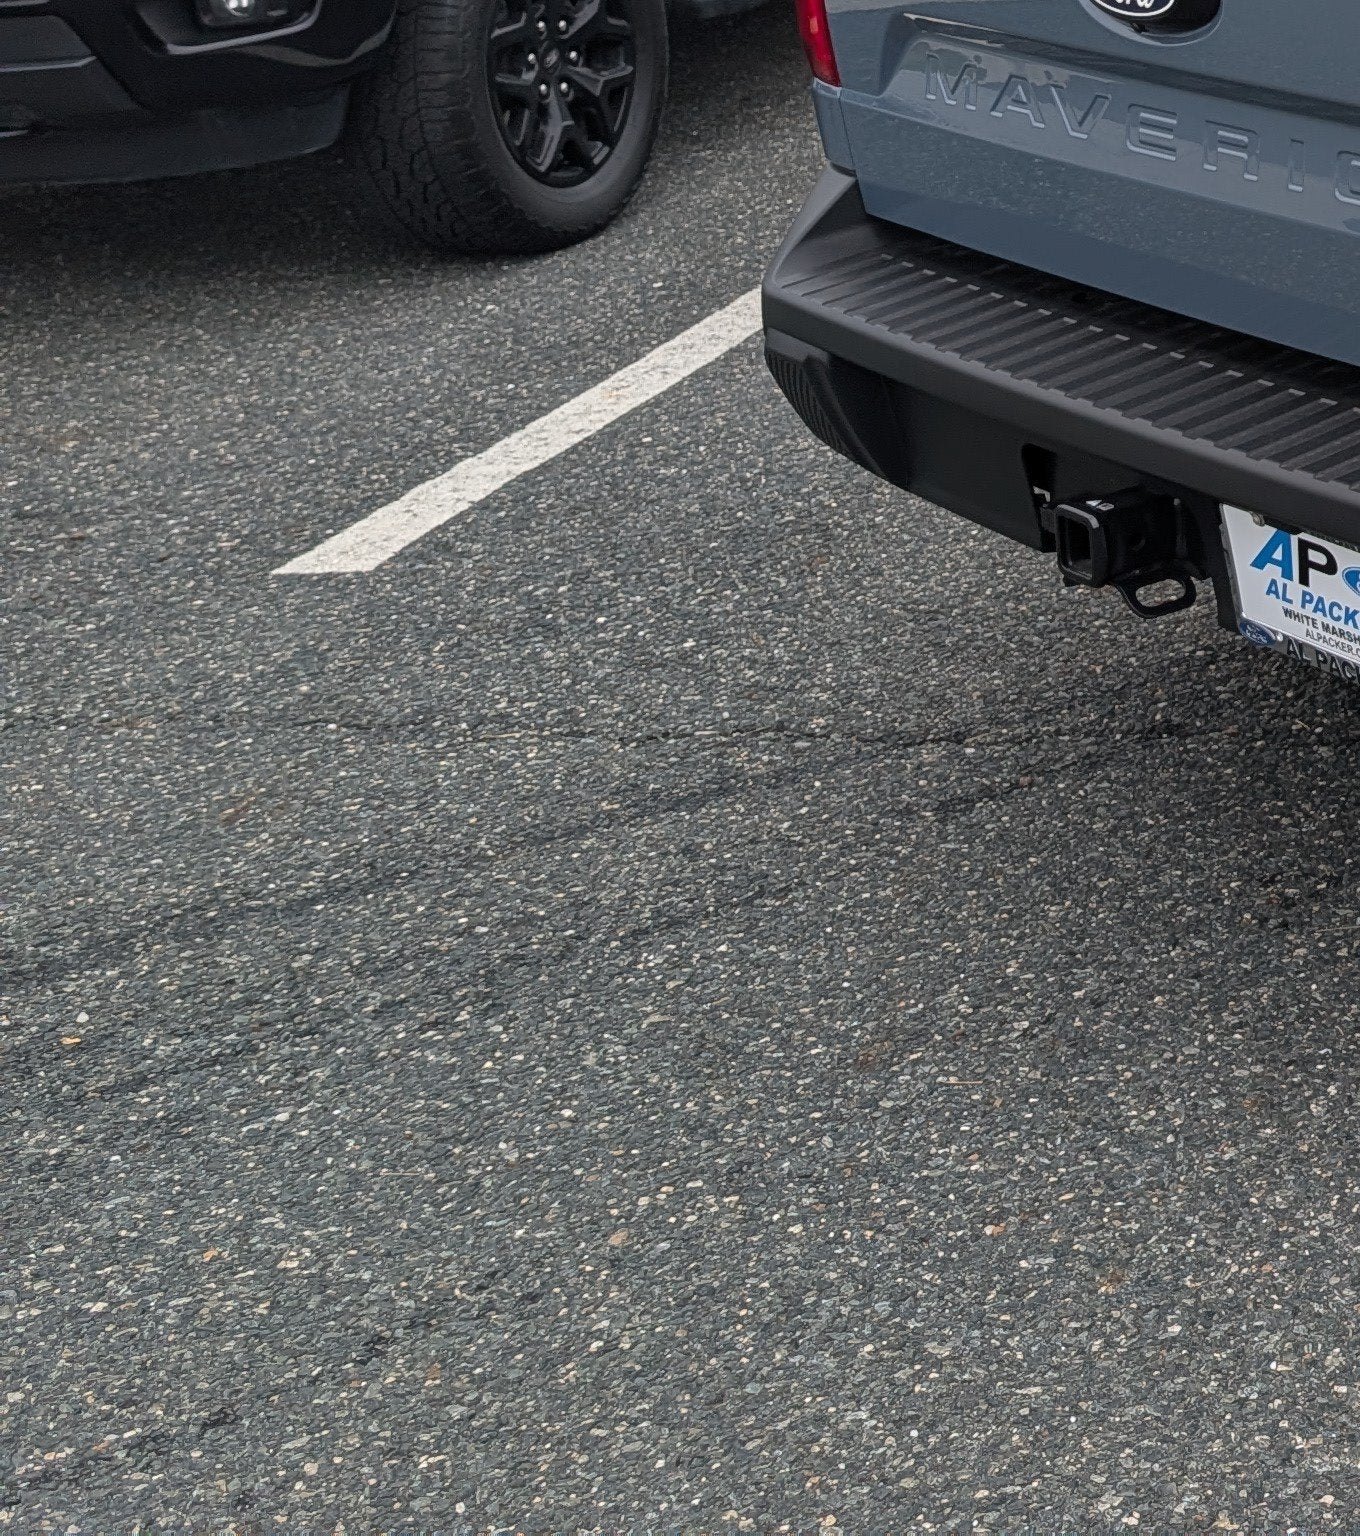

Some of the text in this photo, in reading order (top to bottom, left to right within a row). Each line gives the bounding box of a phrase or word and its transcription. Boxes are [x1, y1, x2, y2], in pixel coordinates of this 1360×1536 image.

[1250, 528, 1338, 588] AP
[1265, 578, 1294, 605] AL
[1282, 605, 1319, 630] WHITE
[1286, 639, 1312, 663] AL
